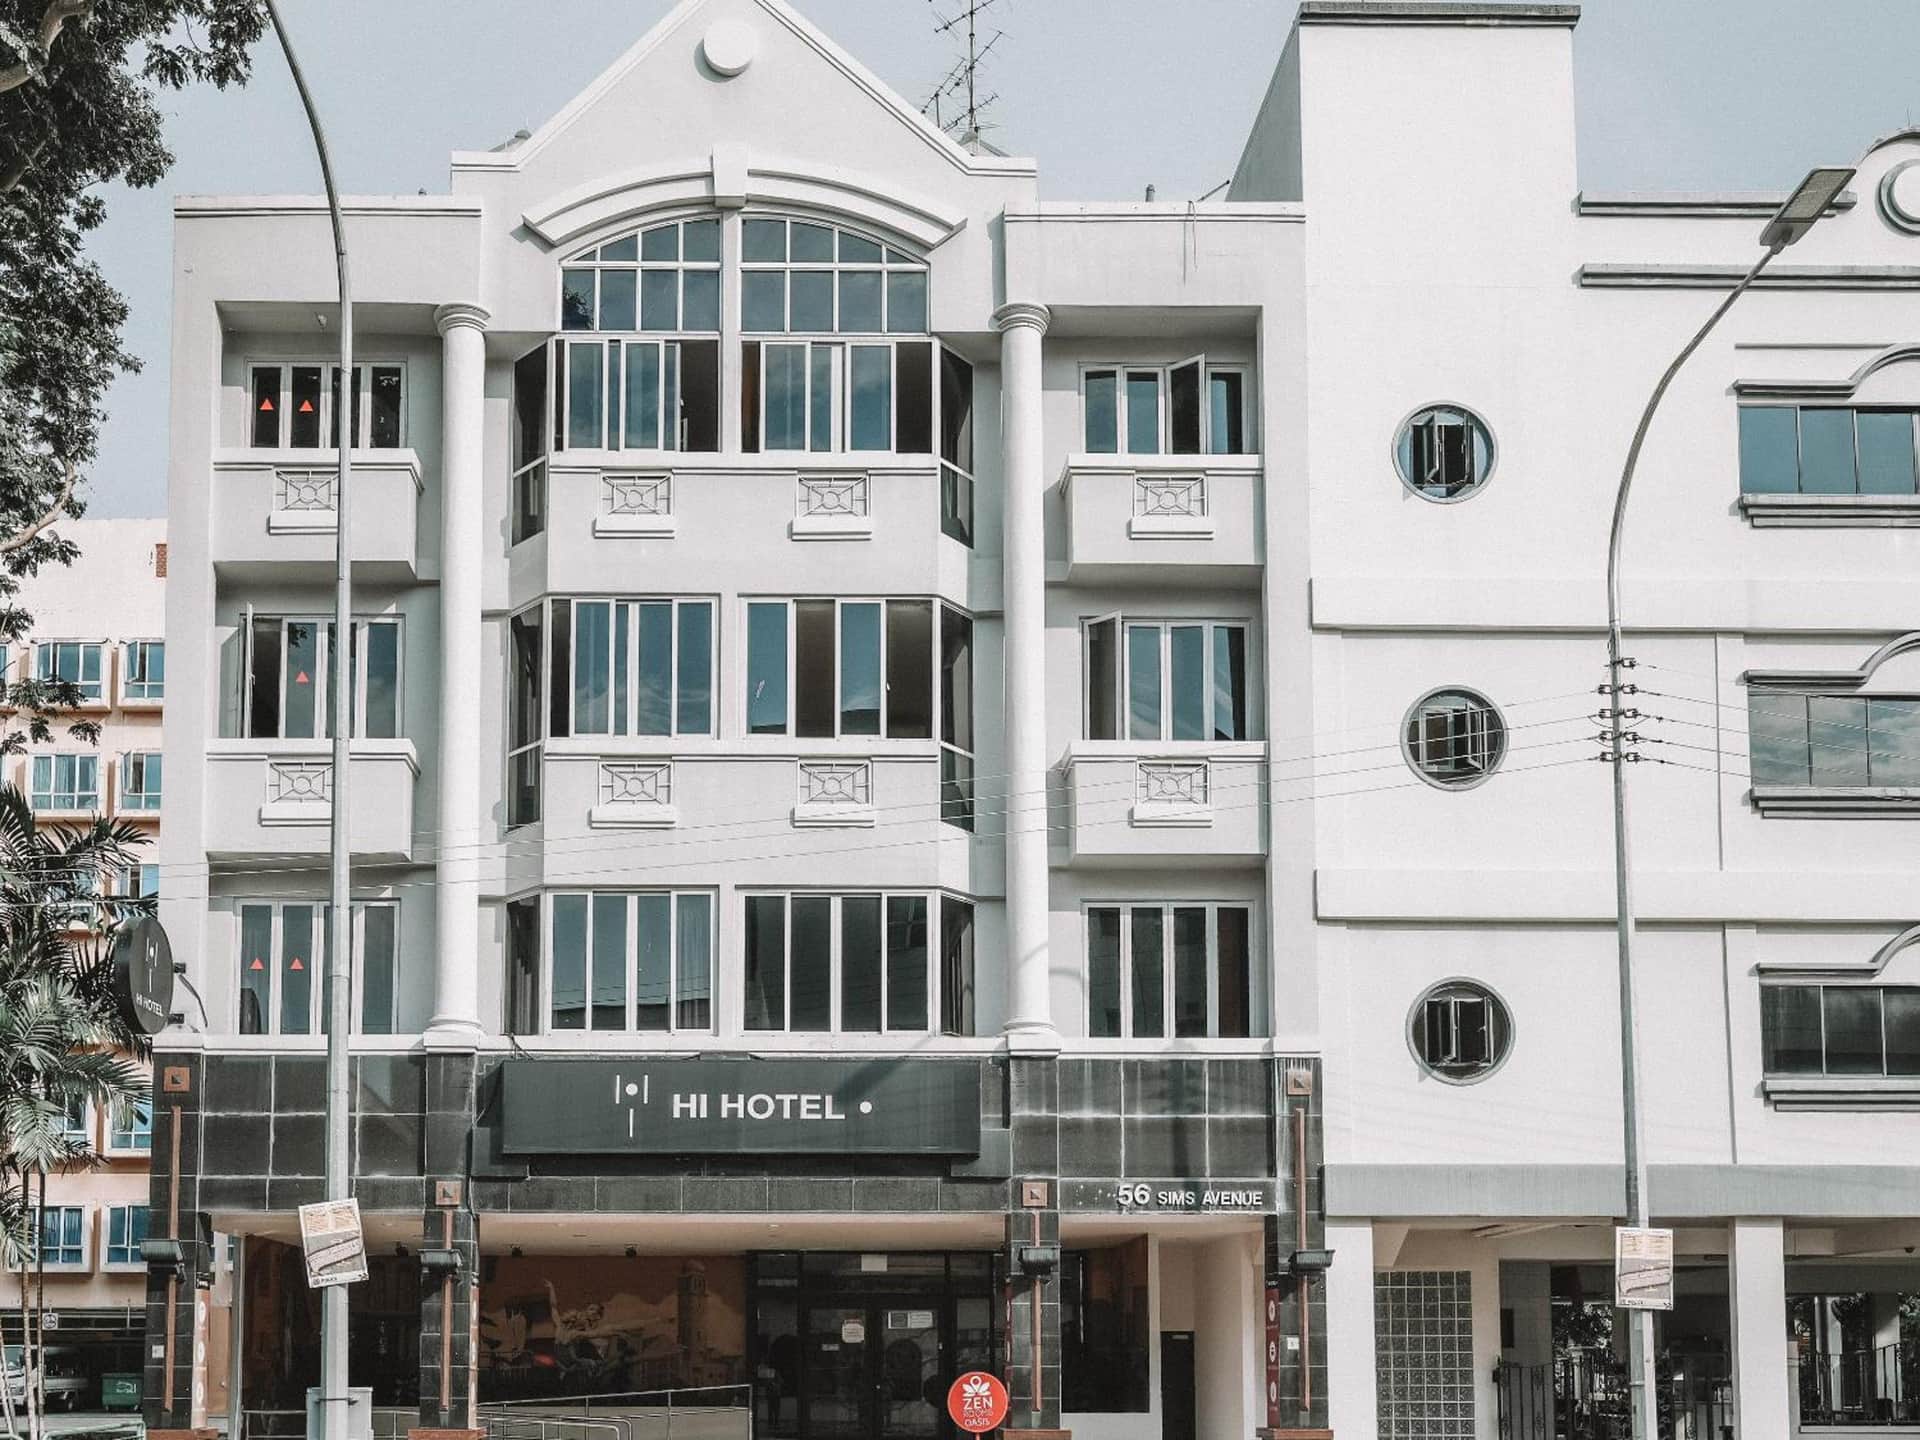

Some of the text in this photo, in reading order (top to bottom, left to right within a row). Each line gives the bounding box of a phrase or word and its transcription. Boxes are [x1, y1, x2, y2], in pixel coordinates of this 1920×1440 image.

[135, 992, 164, 1017] HI HOTEL
[672, 1093, 846, 1120] HI HOTEL
[1118, 1183, 1264, 1205] 56 SIMS AVENUE
[962, 1396, 993, 1410] ZEN
[964, 1417, 991, 1427] OASIS
